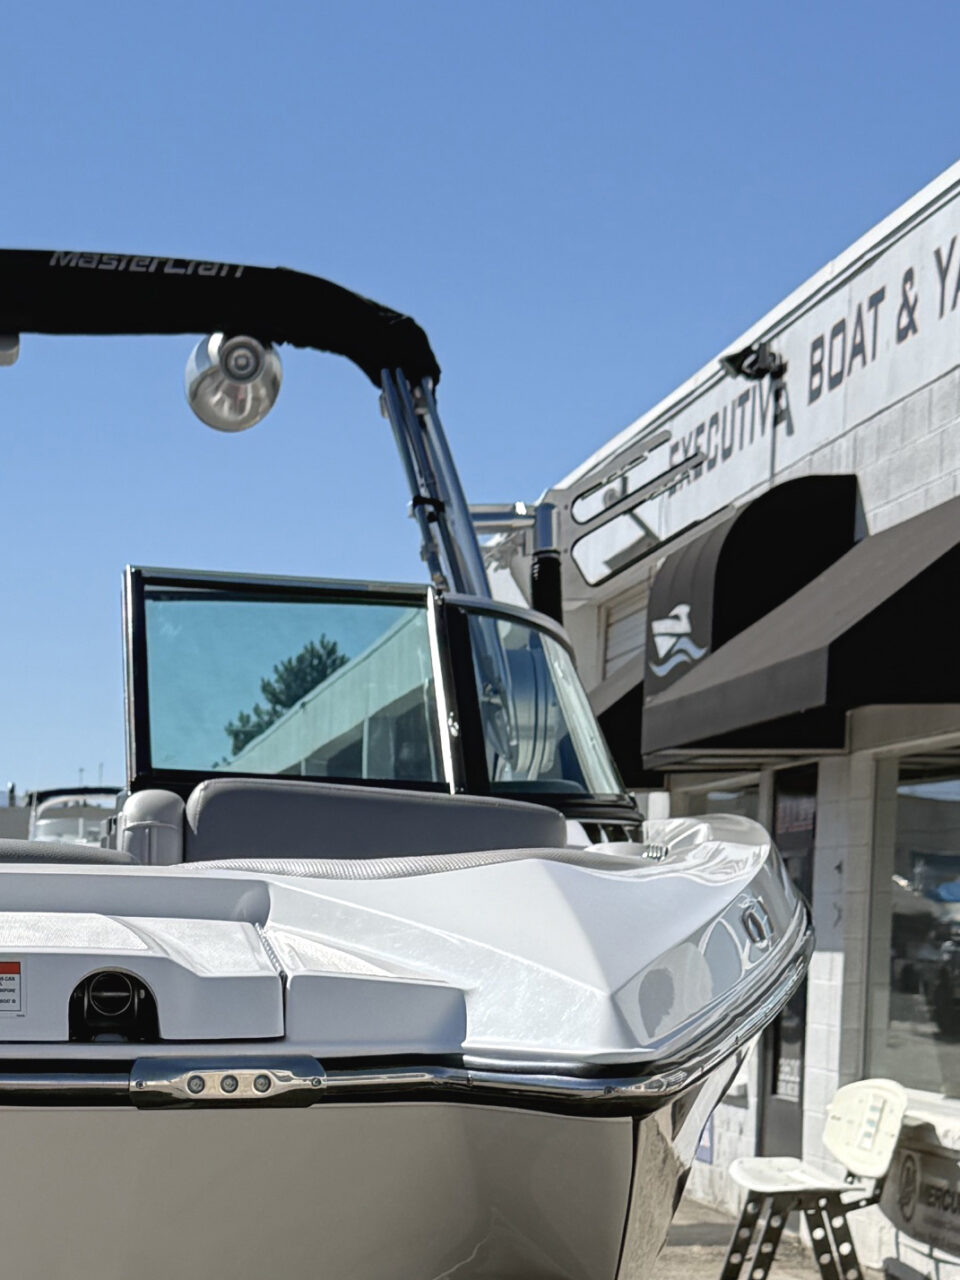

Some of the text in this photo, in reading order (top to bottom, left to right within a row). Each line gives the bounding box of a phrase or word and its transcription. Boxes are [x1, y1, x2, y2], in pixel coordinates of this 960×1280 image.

[669, 377, 790, 497] EXECUTIV
[808, 285, 886, 406] BOAT
[896, 266, 918, 344] &
